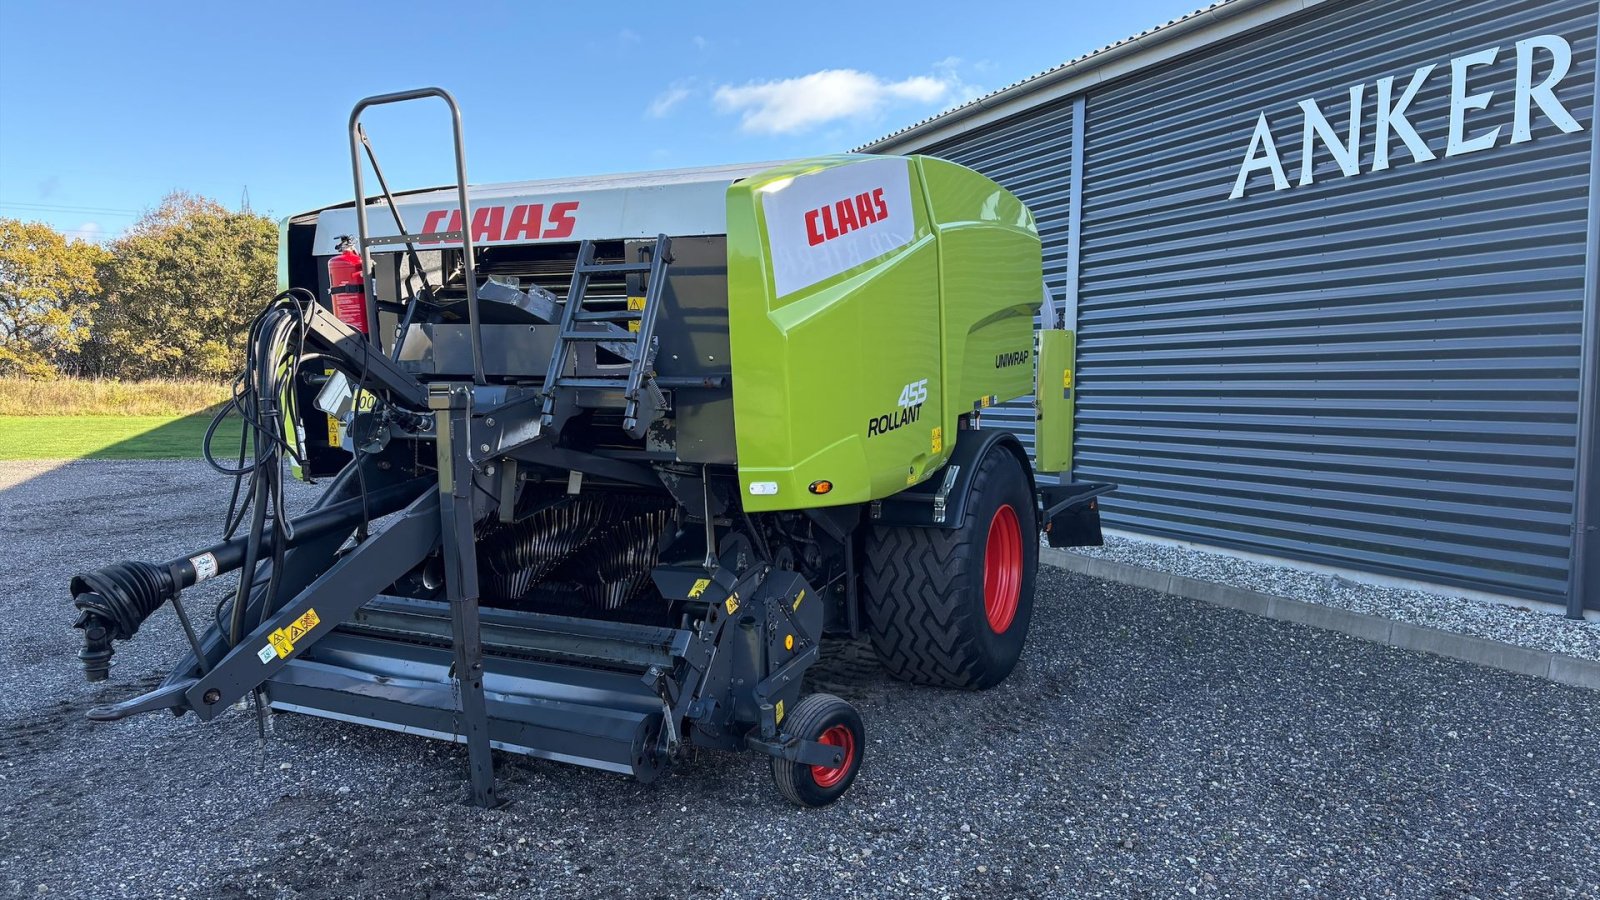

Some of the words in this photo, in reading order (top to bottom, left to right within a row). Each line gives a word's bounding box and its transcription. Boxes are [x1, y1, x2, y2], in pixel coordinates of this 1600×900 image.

[1228, 34, 1583, 200] ANKER
[804, 187, 889, 247] CLAAS
[995, 350, 1029, 369] UNIWRAP
[898, 378, 928, 408] 455
[867, 402, 923, 438] ROLLANT
